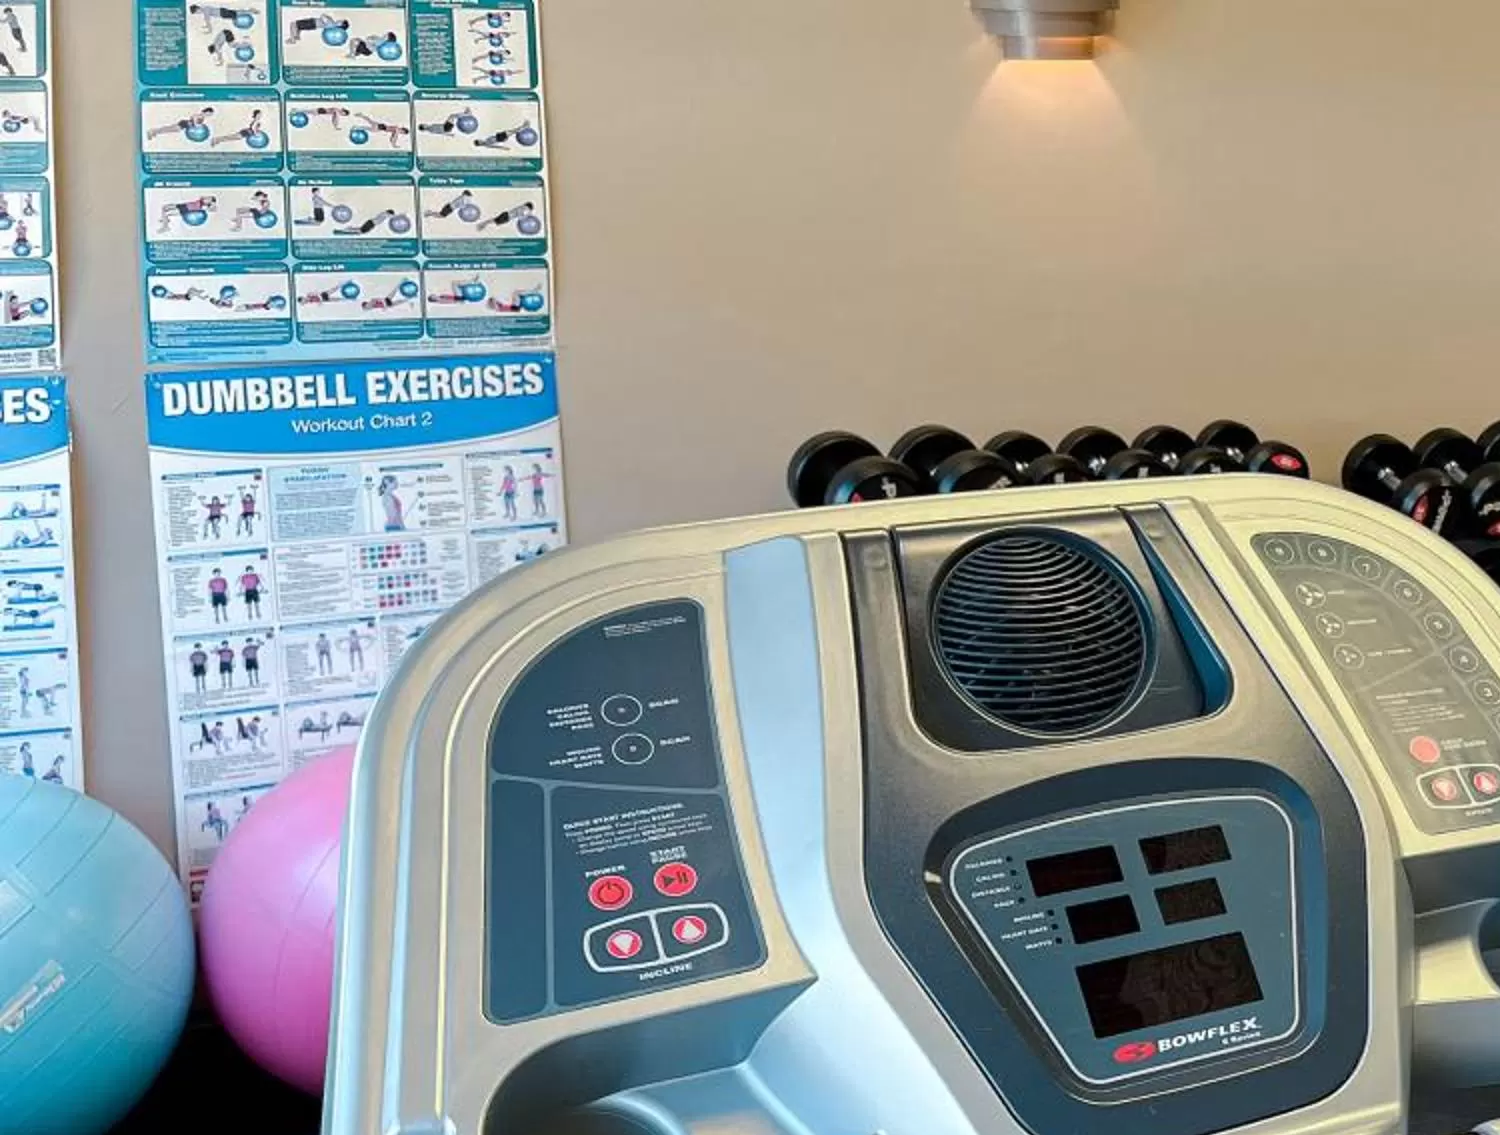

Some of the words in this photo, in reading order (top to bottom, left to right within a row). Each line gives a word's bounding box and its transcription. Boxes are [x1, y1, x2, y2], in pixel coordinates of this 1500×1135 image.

[163, 373, 357, 417] DUMBBELL
[366, 362, 545, 405] EXERCISES
[0, 387, 51, 424] ES
[292, 414, 365, 434] Workout
[370, 412, 417, 430] Chart
[421, 411, 433, 426] 2
[585, 864, 626, 878] POWER
[639, 961, 693, 981] INCLINE
[1157, 1016, 1258, 1053] BOWFLEX
